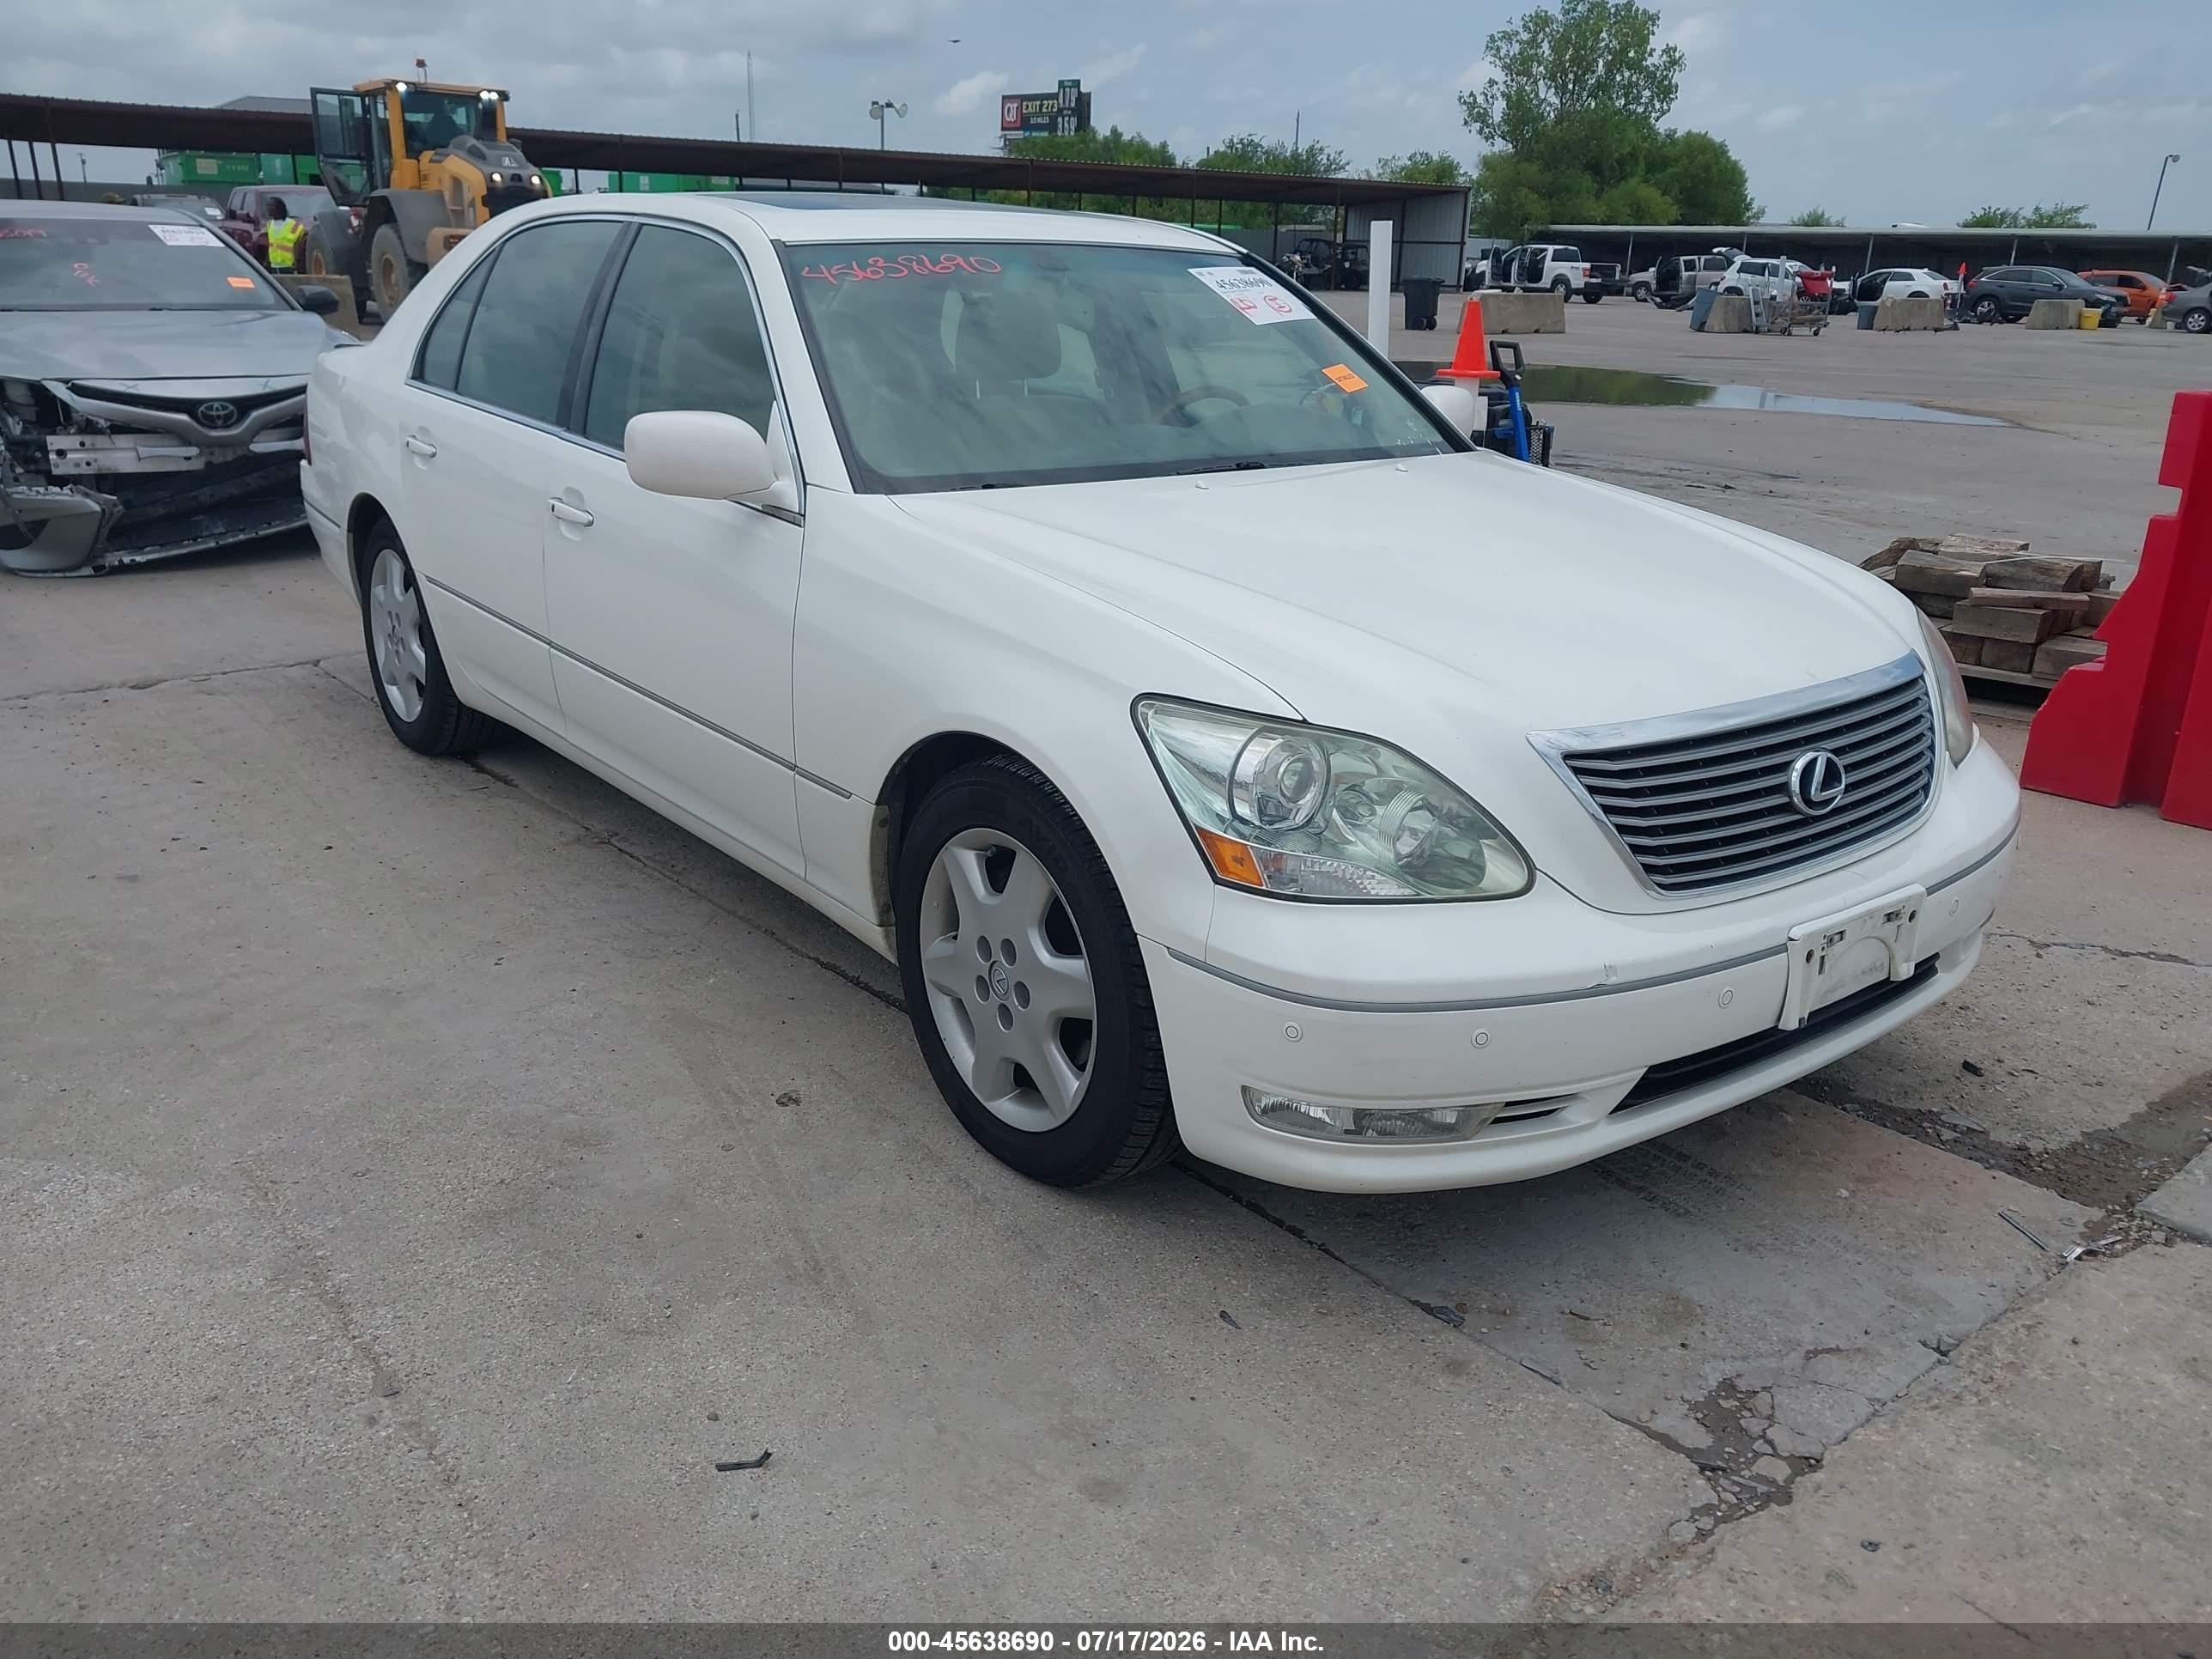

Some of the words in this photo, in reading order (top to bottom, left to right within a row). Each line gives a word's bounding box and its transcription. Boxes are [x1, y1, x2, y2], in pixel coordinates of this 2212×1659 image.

[1005, 103, 1018, 122] QT
[1023, 100, 1040, 113] EXIT
[1042, 100, 1058, 112] 273
[801, 254, 1002, 285] 45638690
